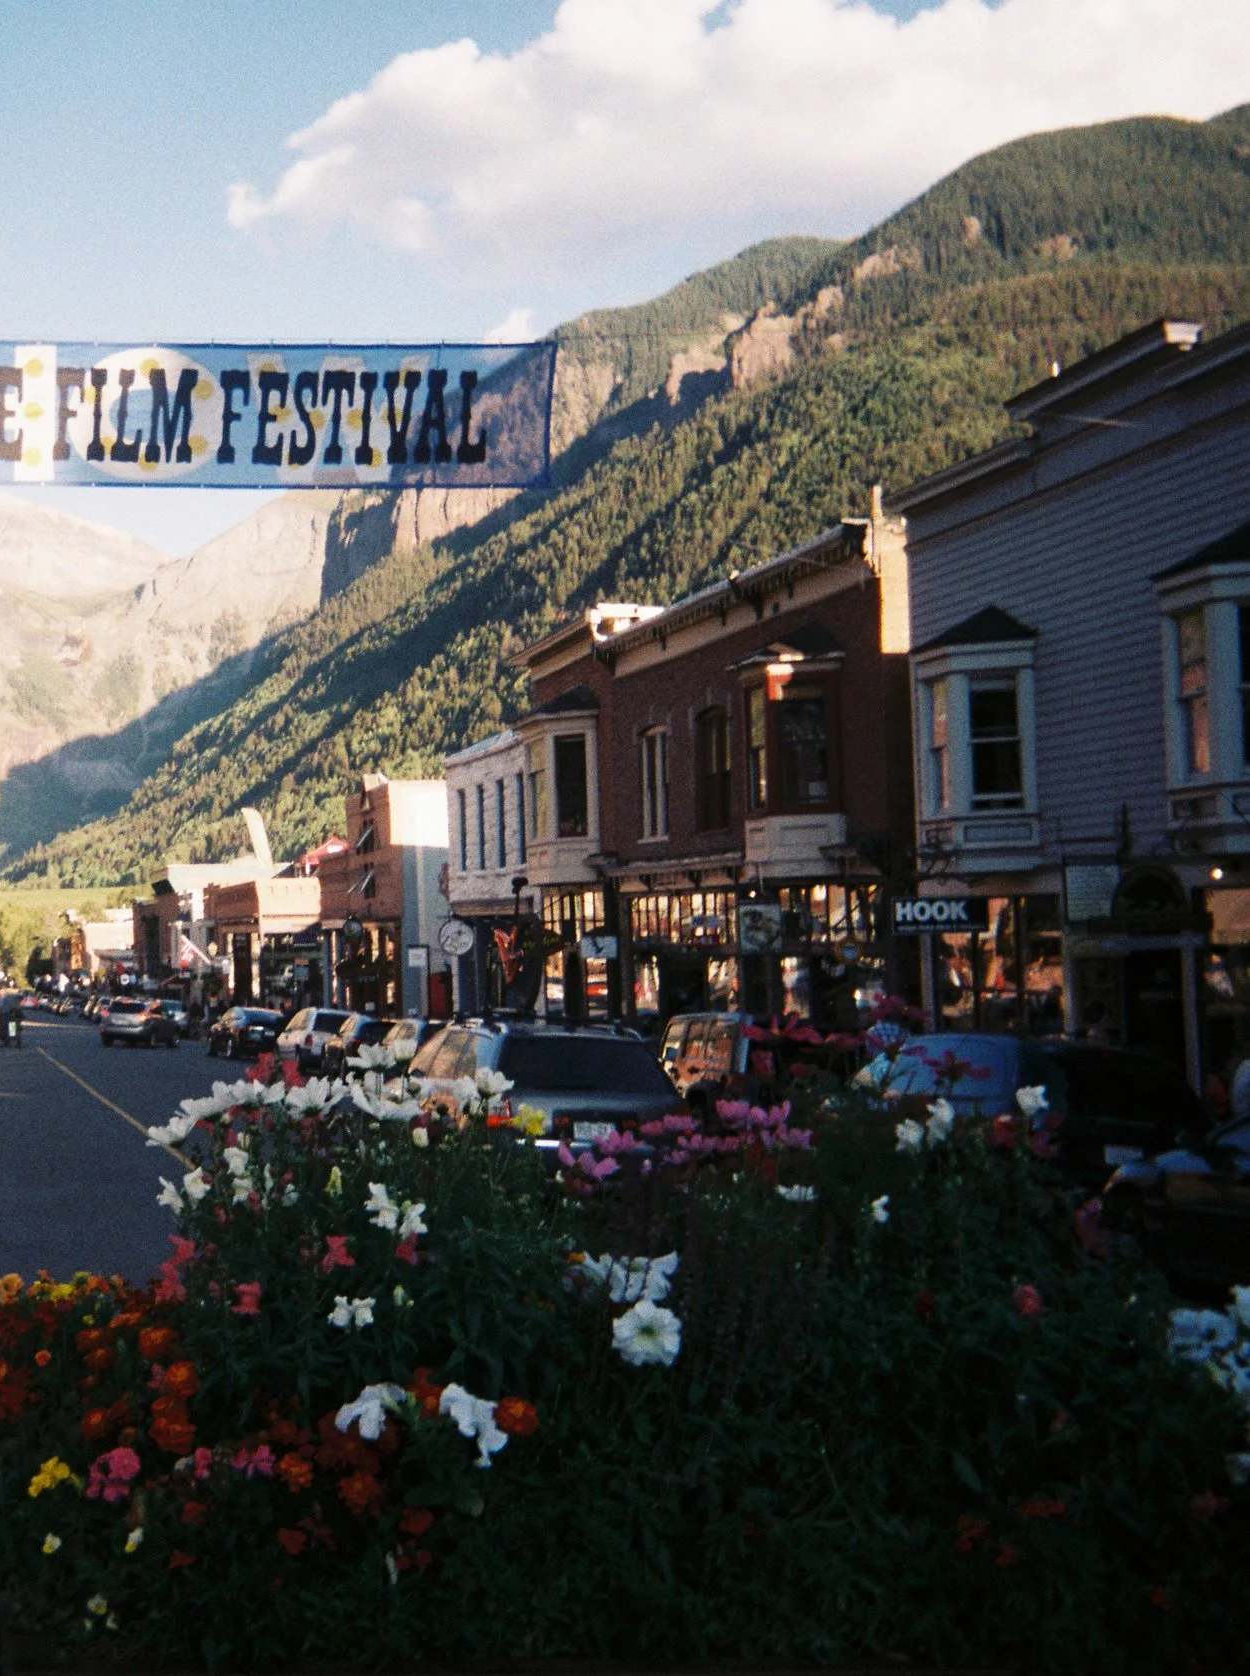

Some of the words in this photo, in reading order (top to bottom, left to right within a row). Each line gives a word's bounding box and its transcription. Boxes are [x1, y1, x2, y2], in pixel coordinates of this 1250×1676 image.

[53, 367, 199, 464] FILM
[216, 369, 487, 466] FESTIVAL
[895, 900, 968, 922] HOOK
